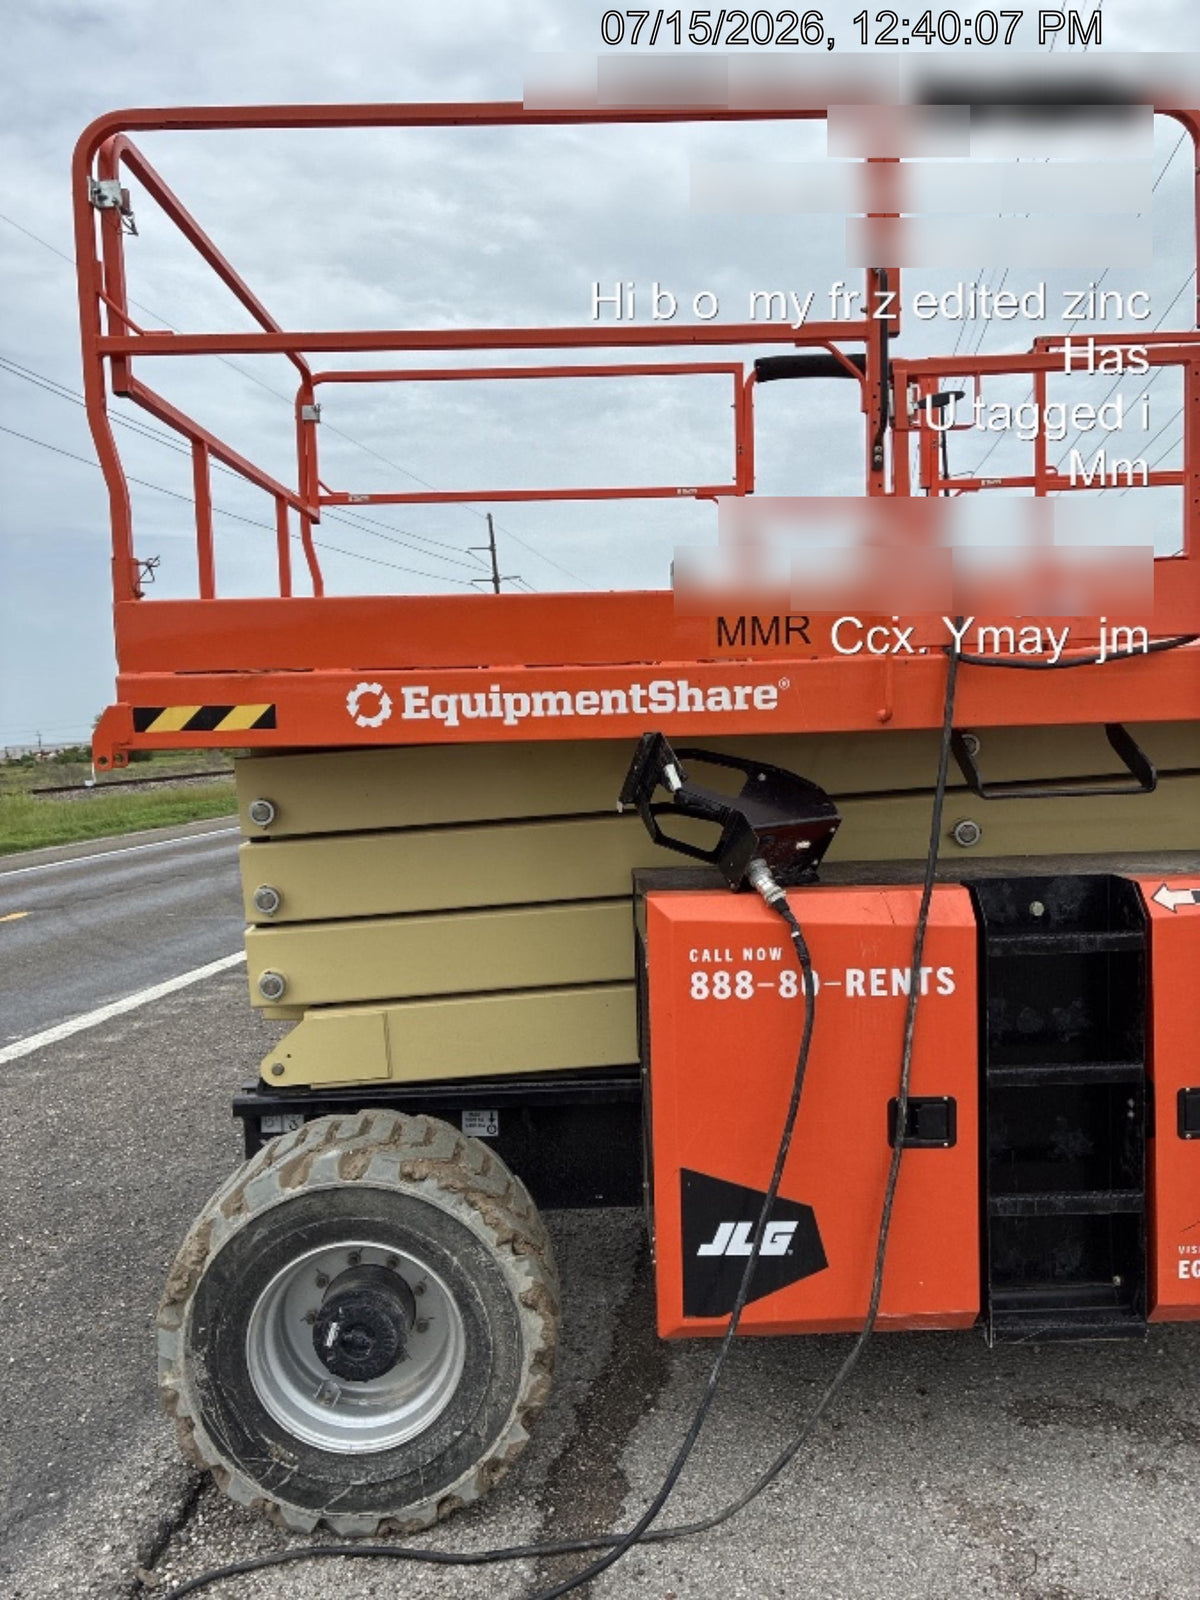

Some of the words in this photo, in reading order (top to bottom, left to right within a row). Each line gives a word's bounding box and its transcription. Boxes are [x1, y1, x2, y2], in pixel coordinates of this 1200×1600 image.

[716, 615, 811, 647] MMR
[689, 948, 734, 962] CALL
[742, 947, 783, 961] NOW
[696, 1220, 800, 1256] JLG
